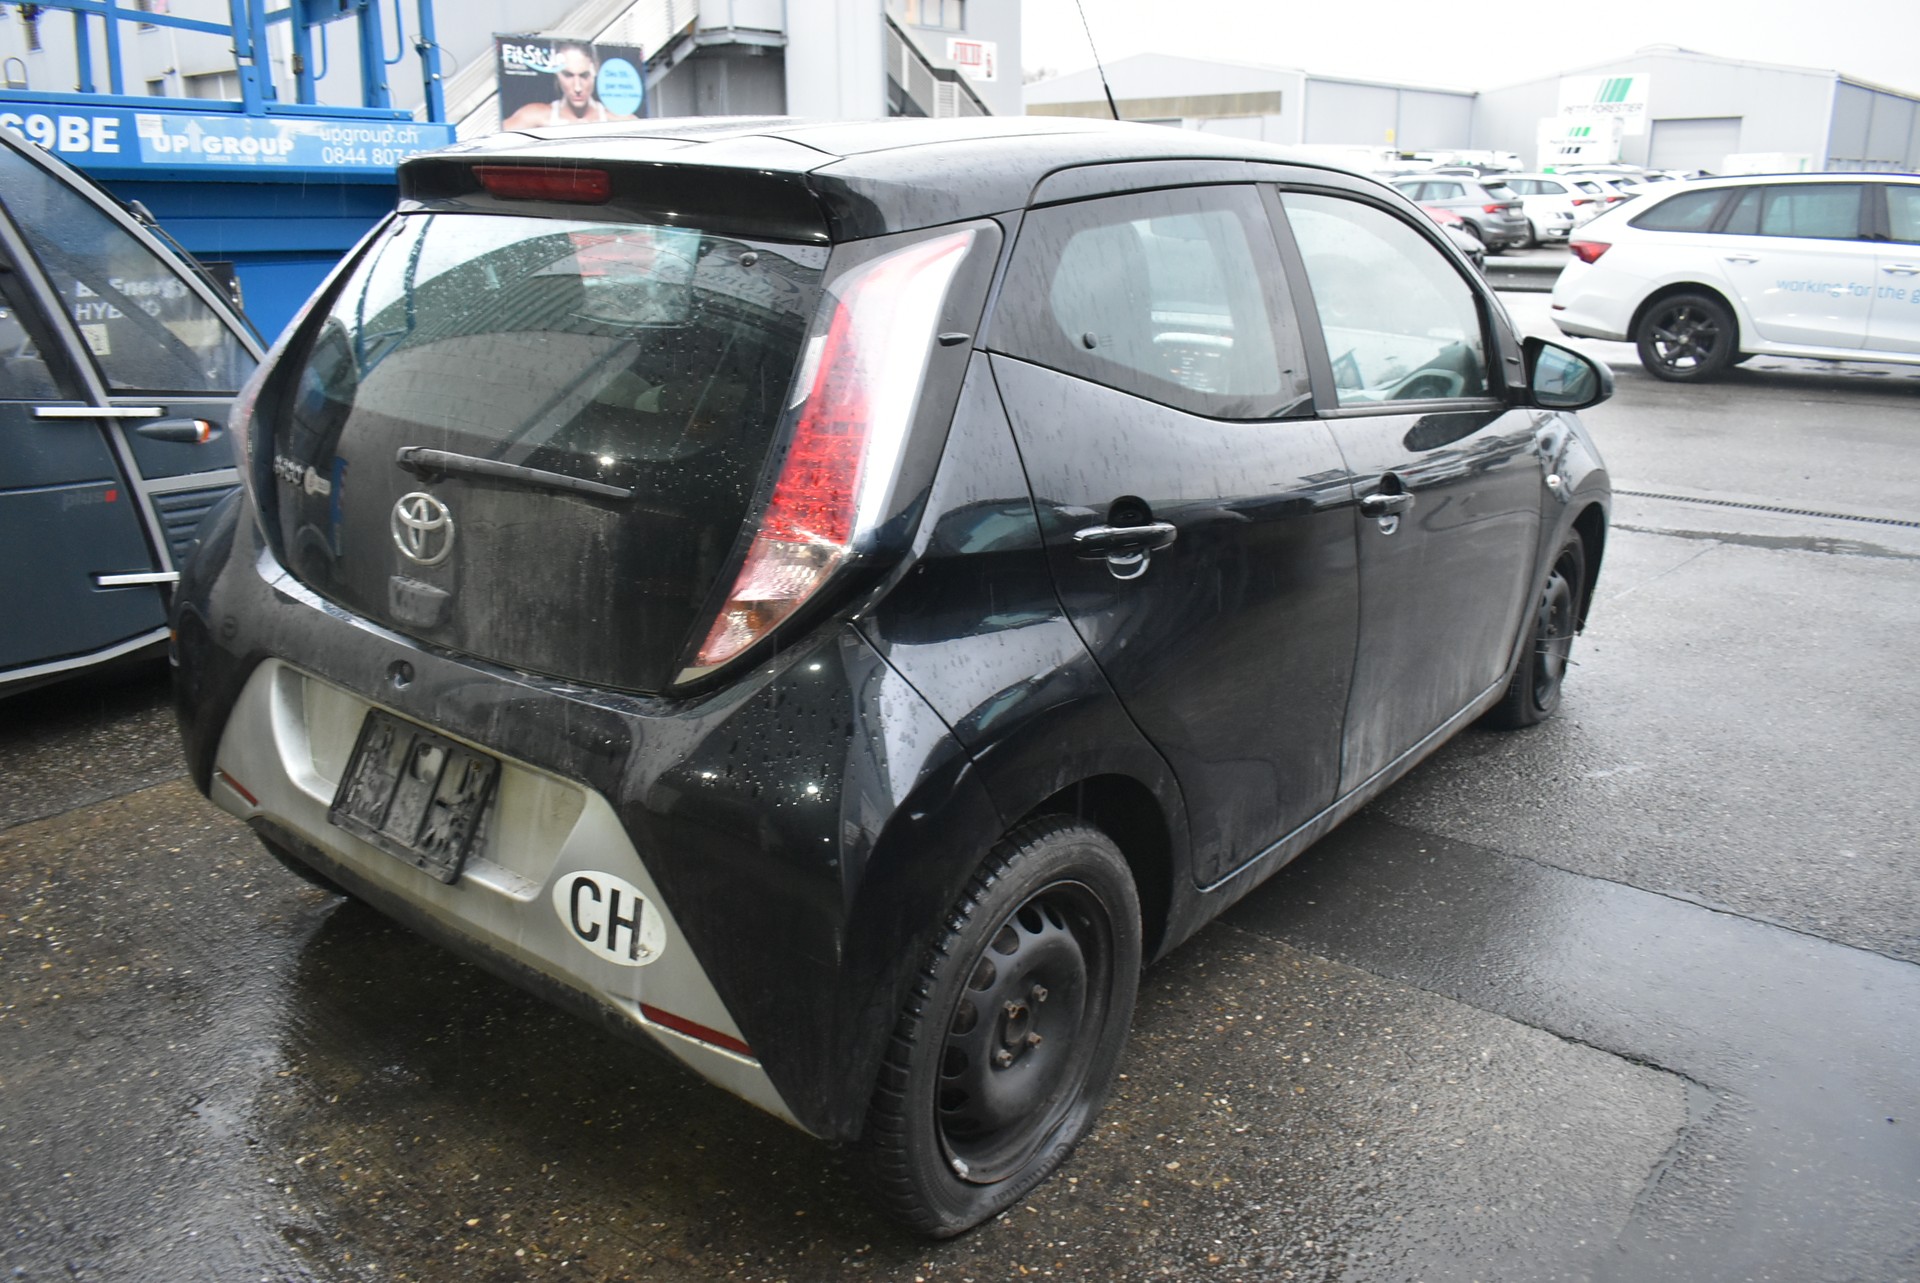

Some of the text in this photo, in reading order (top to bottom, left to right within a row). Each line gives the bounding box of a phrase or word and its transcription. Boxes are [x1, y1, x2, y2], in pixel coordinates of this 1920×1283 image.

[202, 135, 295, 156] GROUP
[320, 127, 419, 146] upgroup.ch
[322, 147, 367, 165] 0844
[1776, 279, 1842, 298] working
[1848, 282, 1872, 297] for
[1877, 285, 1906, 300] the
[570, 876, 644, 961] CH
